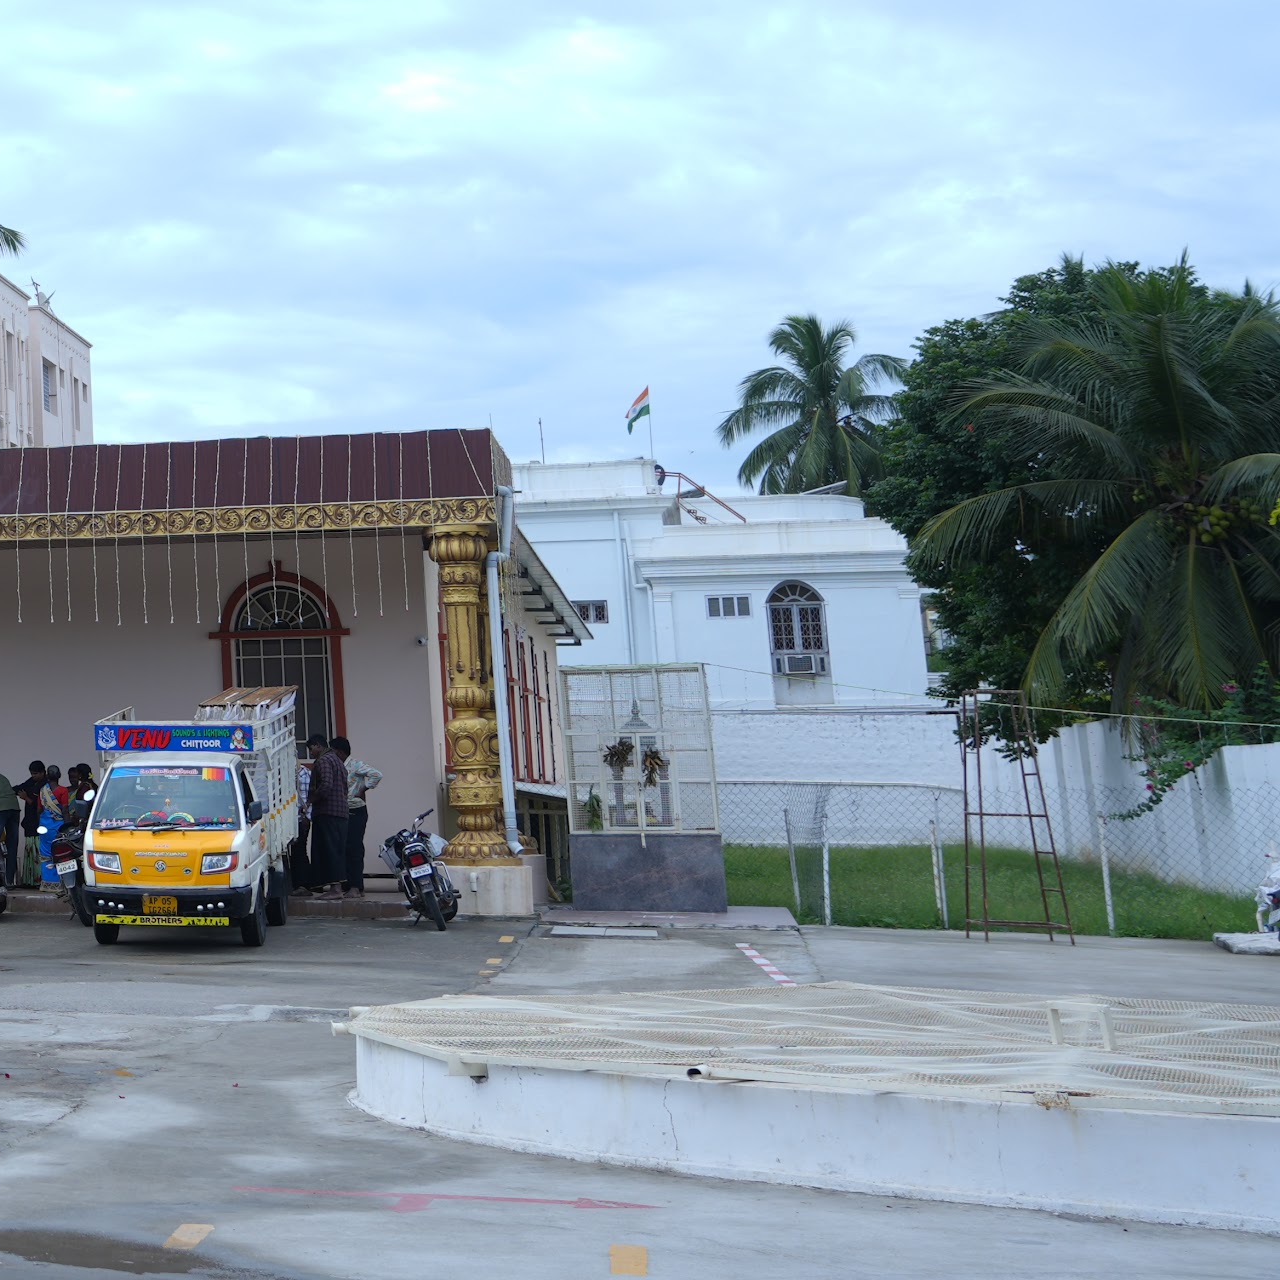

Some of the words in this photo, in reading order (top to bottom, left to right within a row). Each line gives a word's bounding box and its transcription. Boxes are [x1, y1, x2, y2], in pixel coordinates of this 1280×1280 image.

[118, 727, 171, 749] VENU
[203, 729, 230, 738] LIGHTINGS
[181, 739, 221, 749] CHITTOOR
[149, 897, 158, 905] AP
[161, 897, 172, 905] 05
